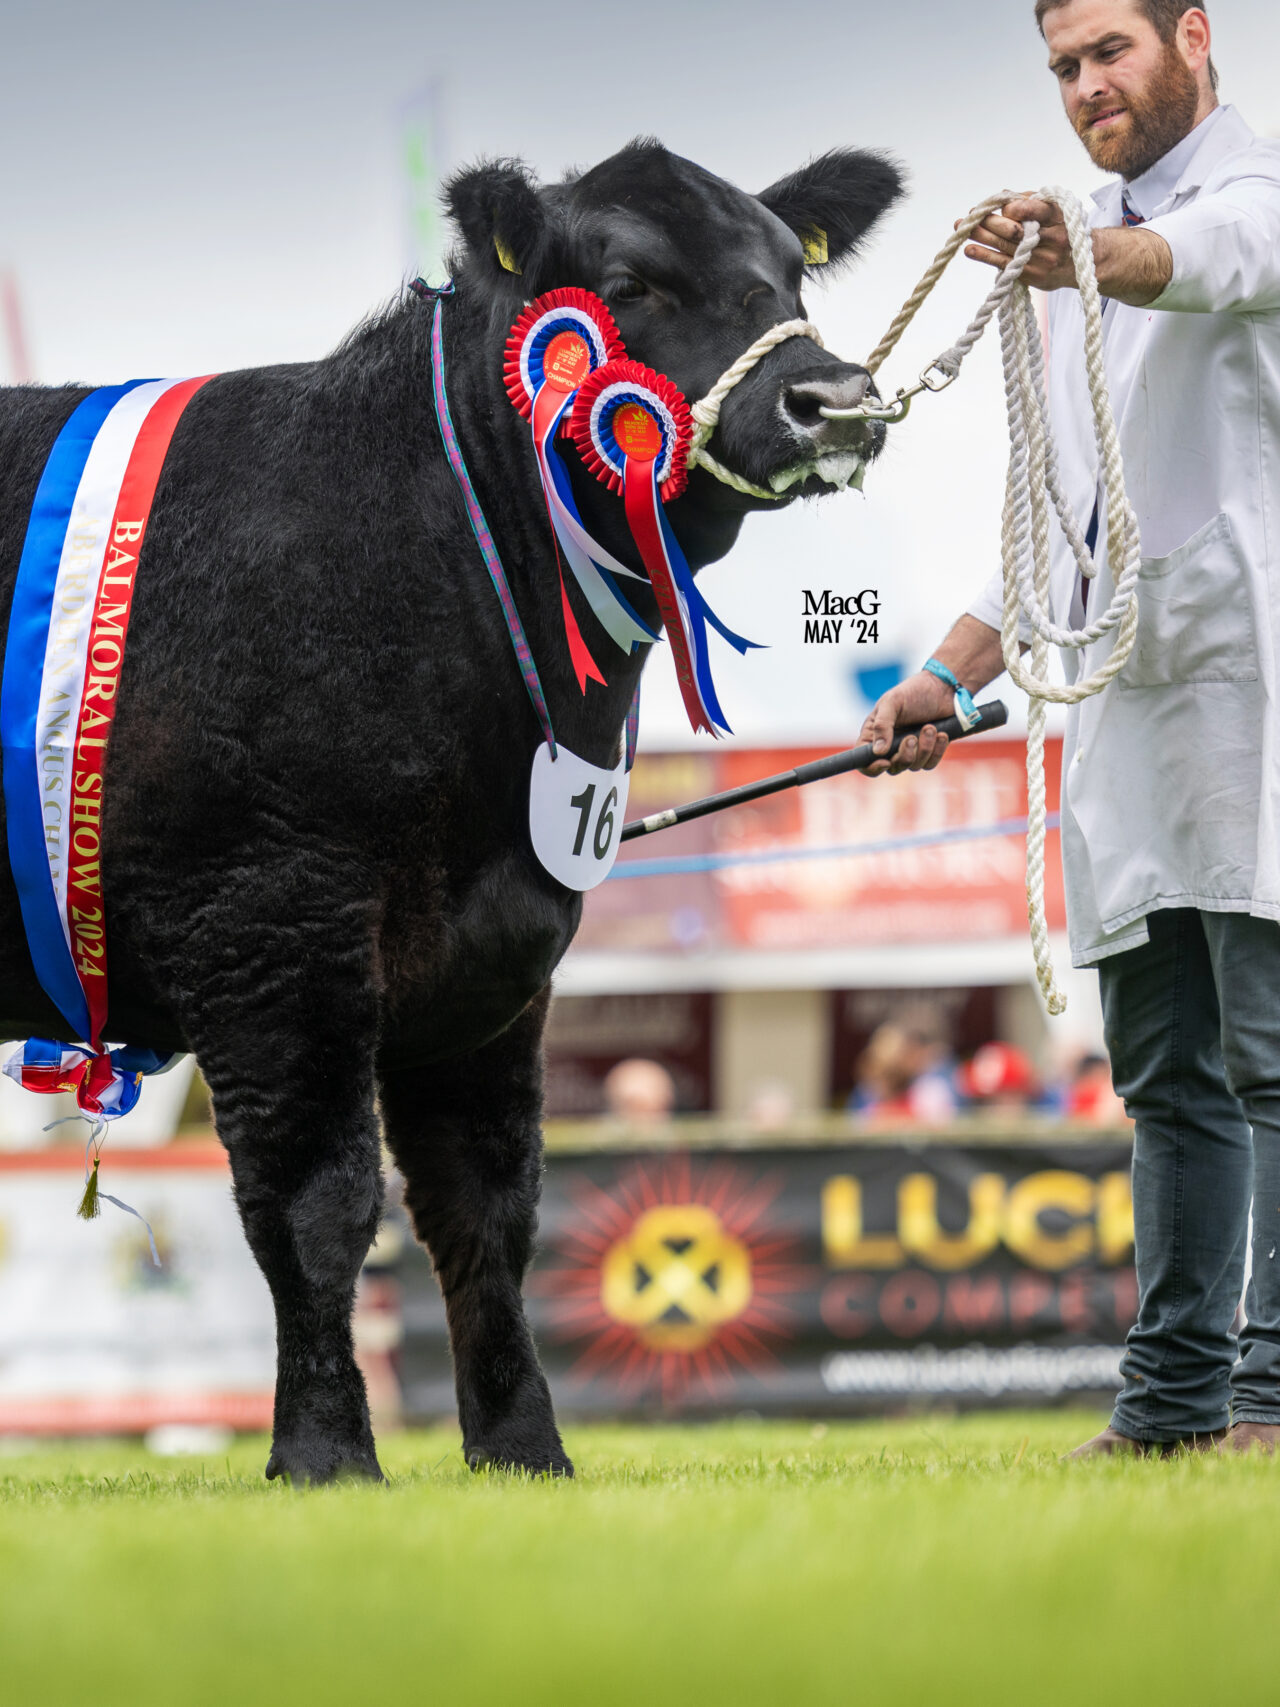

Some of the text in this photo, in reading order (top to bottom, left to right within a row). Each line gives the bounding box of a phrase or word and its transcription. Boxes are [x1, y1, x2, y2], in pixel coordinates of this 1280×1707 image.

[547, 371, 577, 388] CHAMPION
[625, 446, 657, 454] CHAMPION
[49, 508, 99, 682] ABERDEEN
[651, 568, 692, 688] CHAMPION
[42, 687, 72, 792] ANGUS
[71, 517, 145, 977] BALMORAL SHOW 2024
[570, 783, 618, 861] 16
